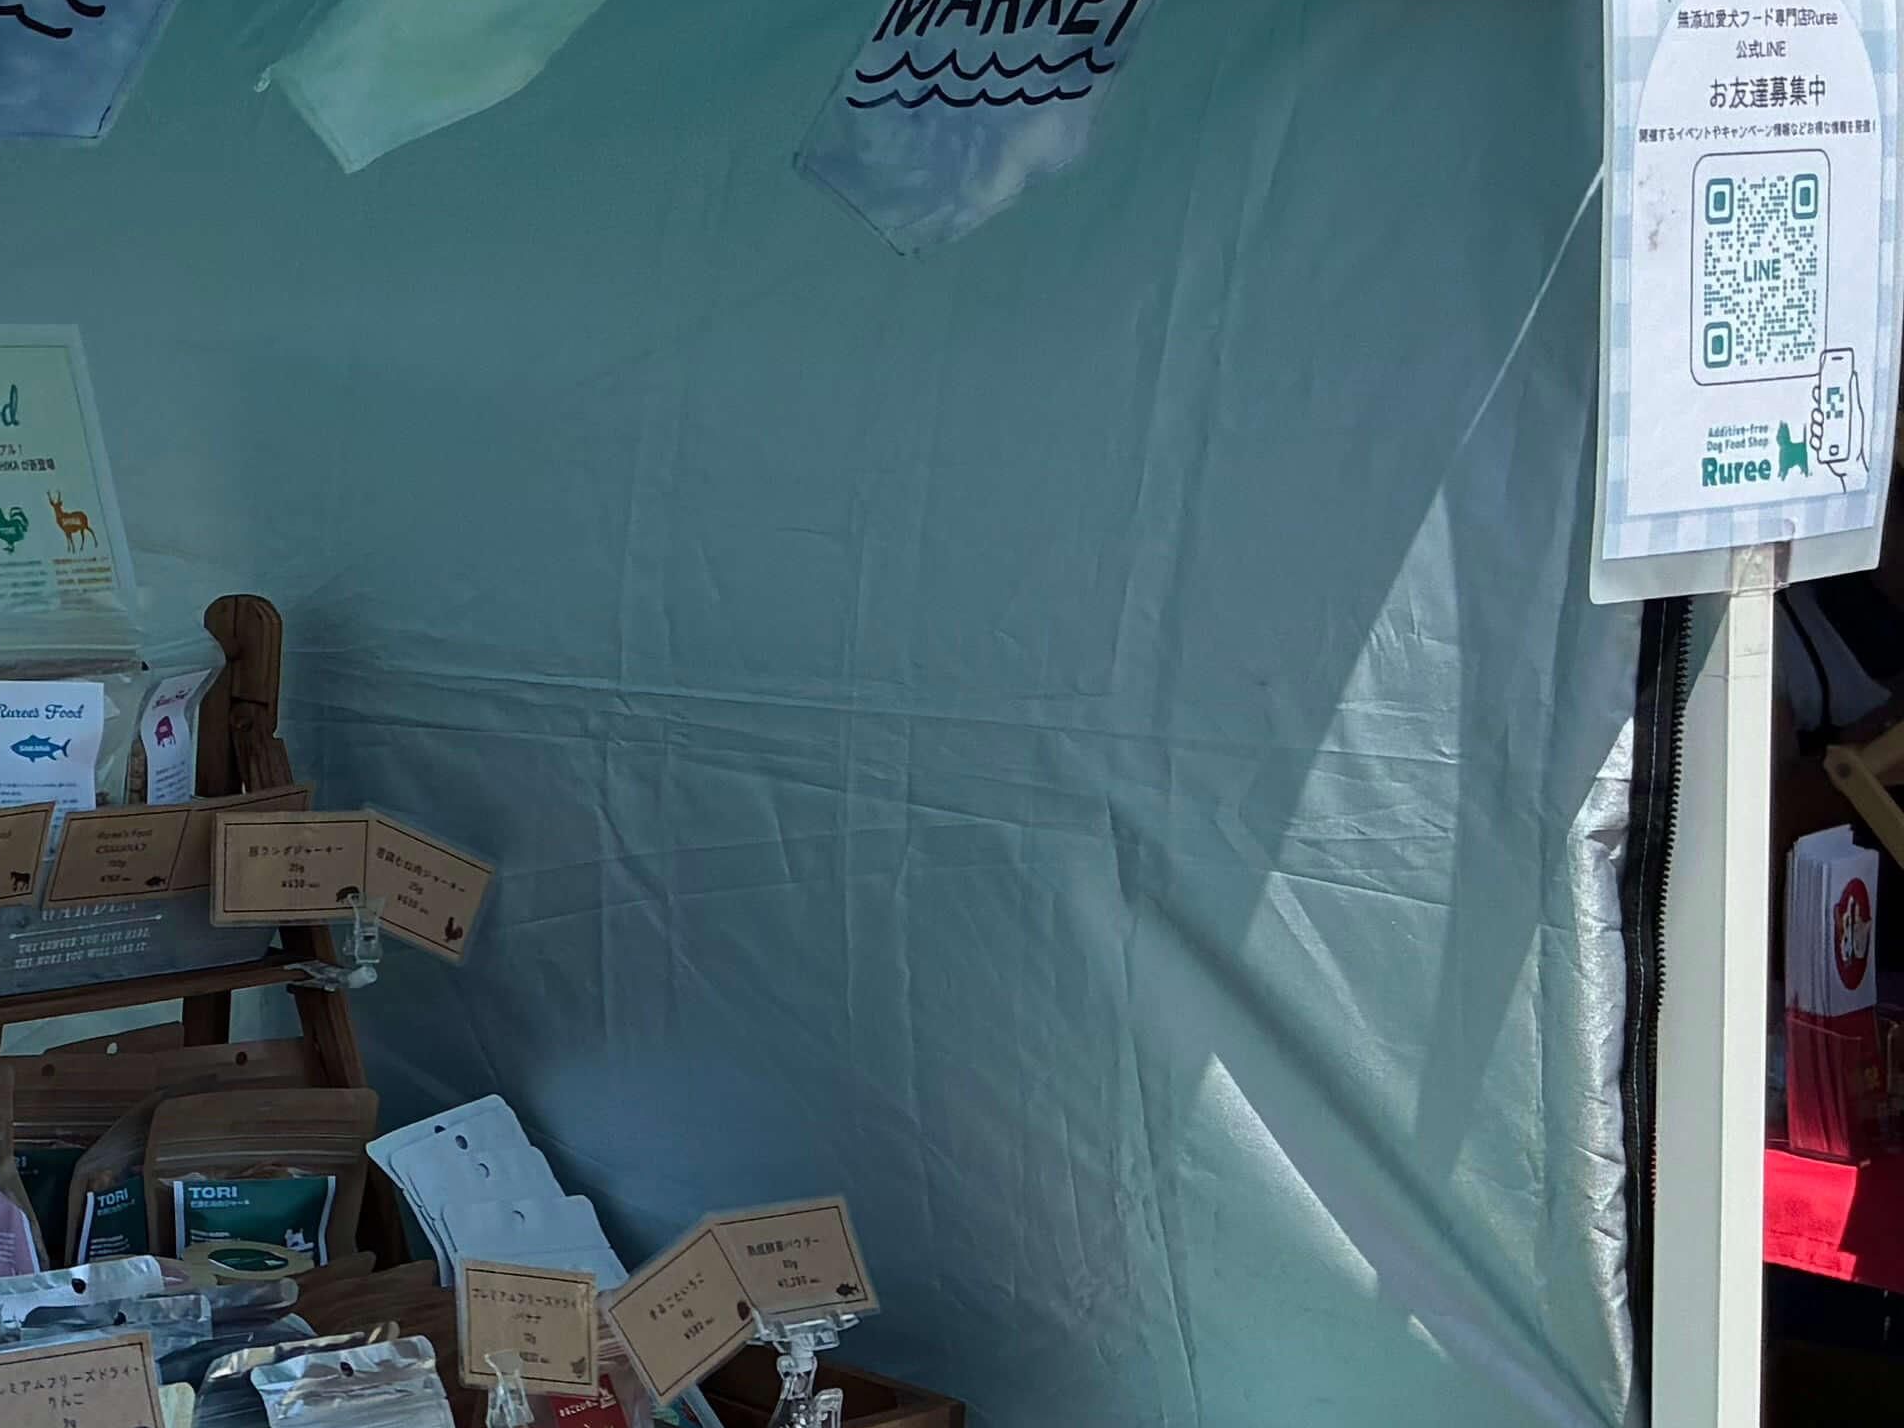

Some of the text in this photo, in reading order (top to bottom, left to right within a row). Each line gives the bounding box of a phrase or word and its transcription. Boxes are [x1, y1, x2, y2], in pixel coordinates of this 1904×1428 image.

[1736, 41, 1787, 59] 公式LINE
[1709, 74, 1826, 109] お友達募集中
[1743, 259, 1781, 282] LINE
[1702, 456, 1772, 487] Ruree
[45, 703, 85, 720] Food
[97, 1188, 129, 1206] TORI
[188, 1185, 238, 1199] TORI
